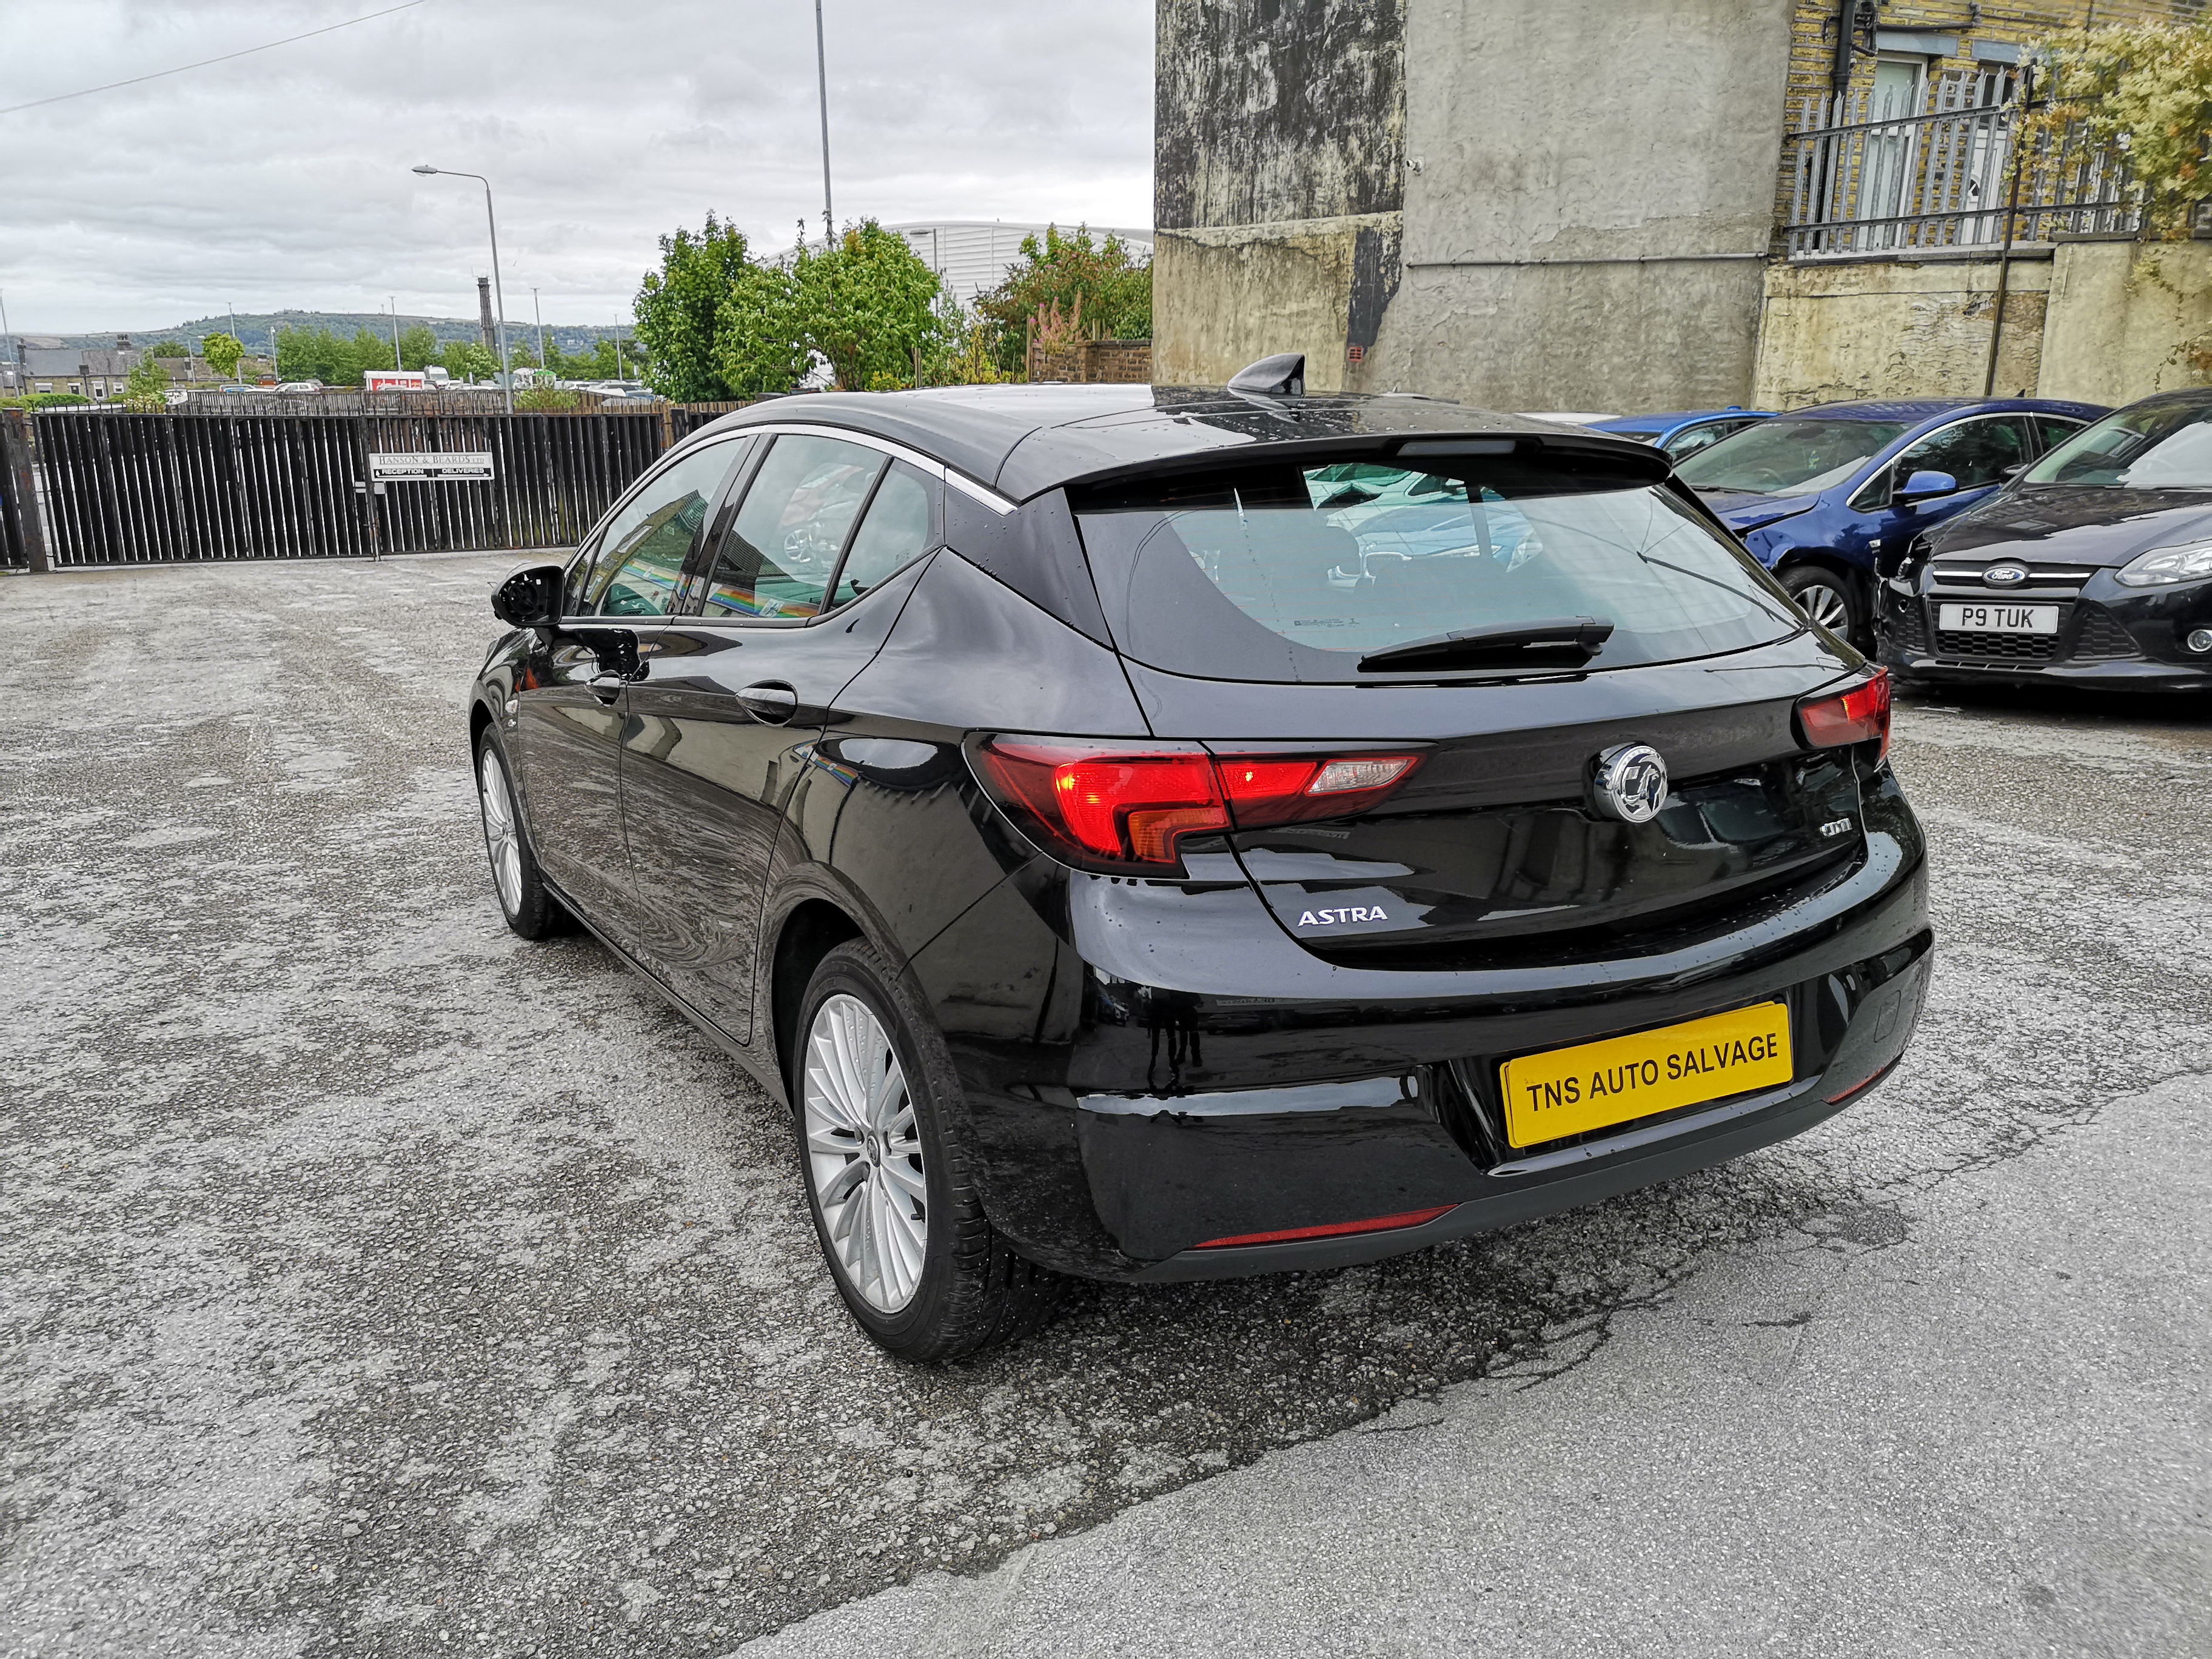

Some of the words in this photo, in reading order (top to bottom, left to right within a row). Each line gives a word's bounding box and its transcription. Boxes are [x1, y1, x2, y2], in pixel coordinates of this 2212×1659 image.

[379, 456, 419, 464] HANSON
[1991, 569, 2015, 580] Ford
[1962, 608, 1987, 626] P9
[1994, 608, 2034, 628] TUK
[1297, 906, 1388, 927] ASTRA
[1526, 1077, 1581, 1112] TNS
[1589, 1059, 1659, 1099] AUTO
[1666, 1033, 1778, 1081] SALVAGE
